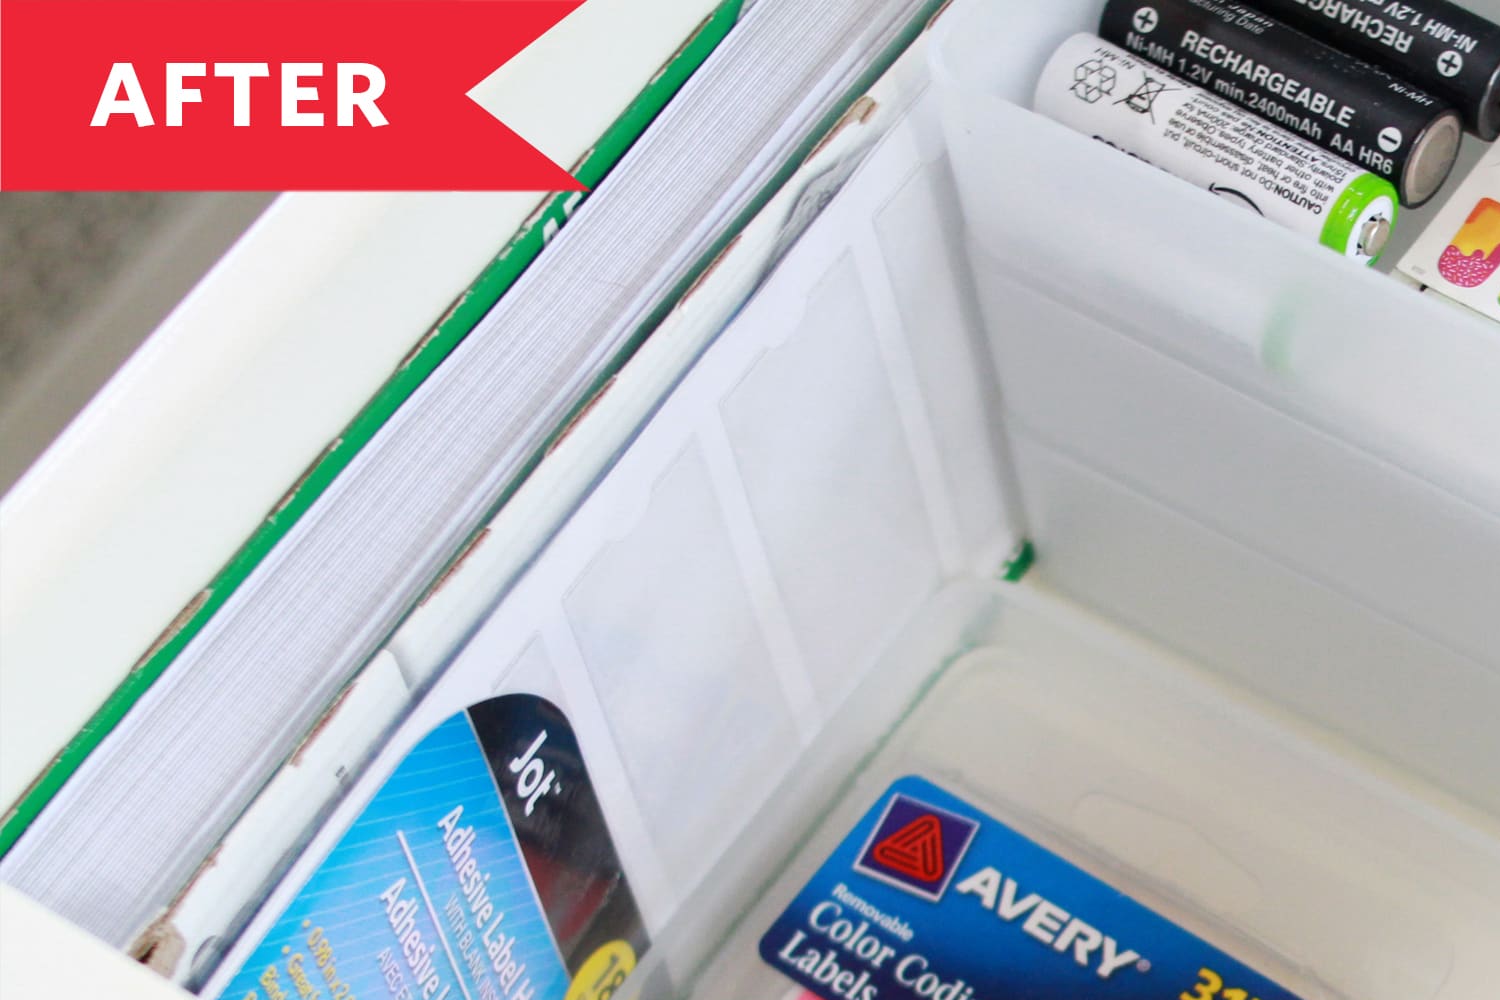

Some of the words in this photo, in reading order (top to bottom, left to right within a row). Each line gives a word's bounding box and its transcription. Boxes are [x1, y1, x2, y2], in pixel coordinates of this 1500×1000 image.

[1234, 14, 1264, 34] Date
[1384, 1, 1424, 27] 1.2V
[1422, 18, 1479, 53] Ni-MH
[1183, 31, 1353, 127] RECHARGEABLE
[1389, 83, 1432, 104] Ni-MH
[1122, 32, 1177, 64] Ni-MH
[1179, 59, 1211, 82] 1.2V
[1216, 80, 1320, 137] min.2400mAh
[1331, 134, 1352, 155] AA
[1358, 146, 1391, 175] HR6
[1197, 133, 1252, 168] disassemble
[1248, 145, 1282, 166] battery
[1241, 168, 1256, 179] not
[1285, 165, 1310, 181] other
[1310, 189, 1327, 202] into
[436, 804, 497, 923] Adhesive
[482, 914, 528, 992] Label
[833, 881, 916, 942] Removable
[379, 877, 441, 996] Adhesive
[440, 896, 469, 937] WITH
[455, 932, 484, 982] BLANK
[808, 900, 895, 973] Color
[376, 948, 399, 993] AVEC
